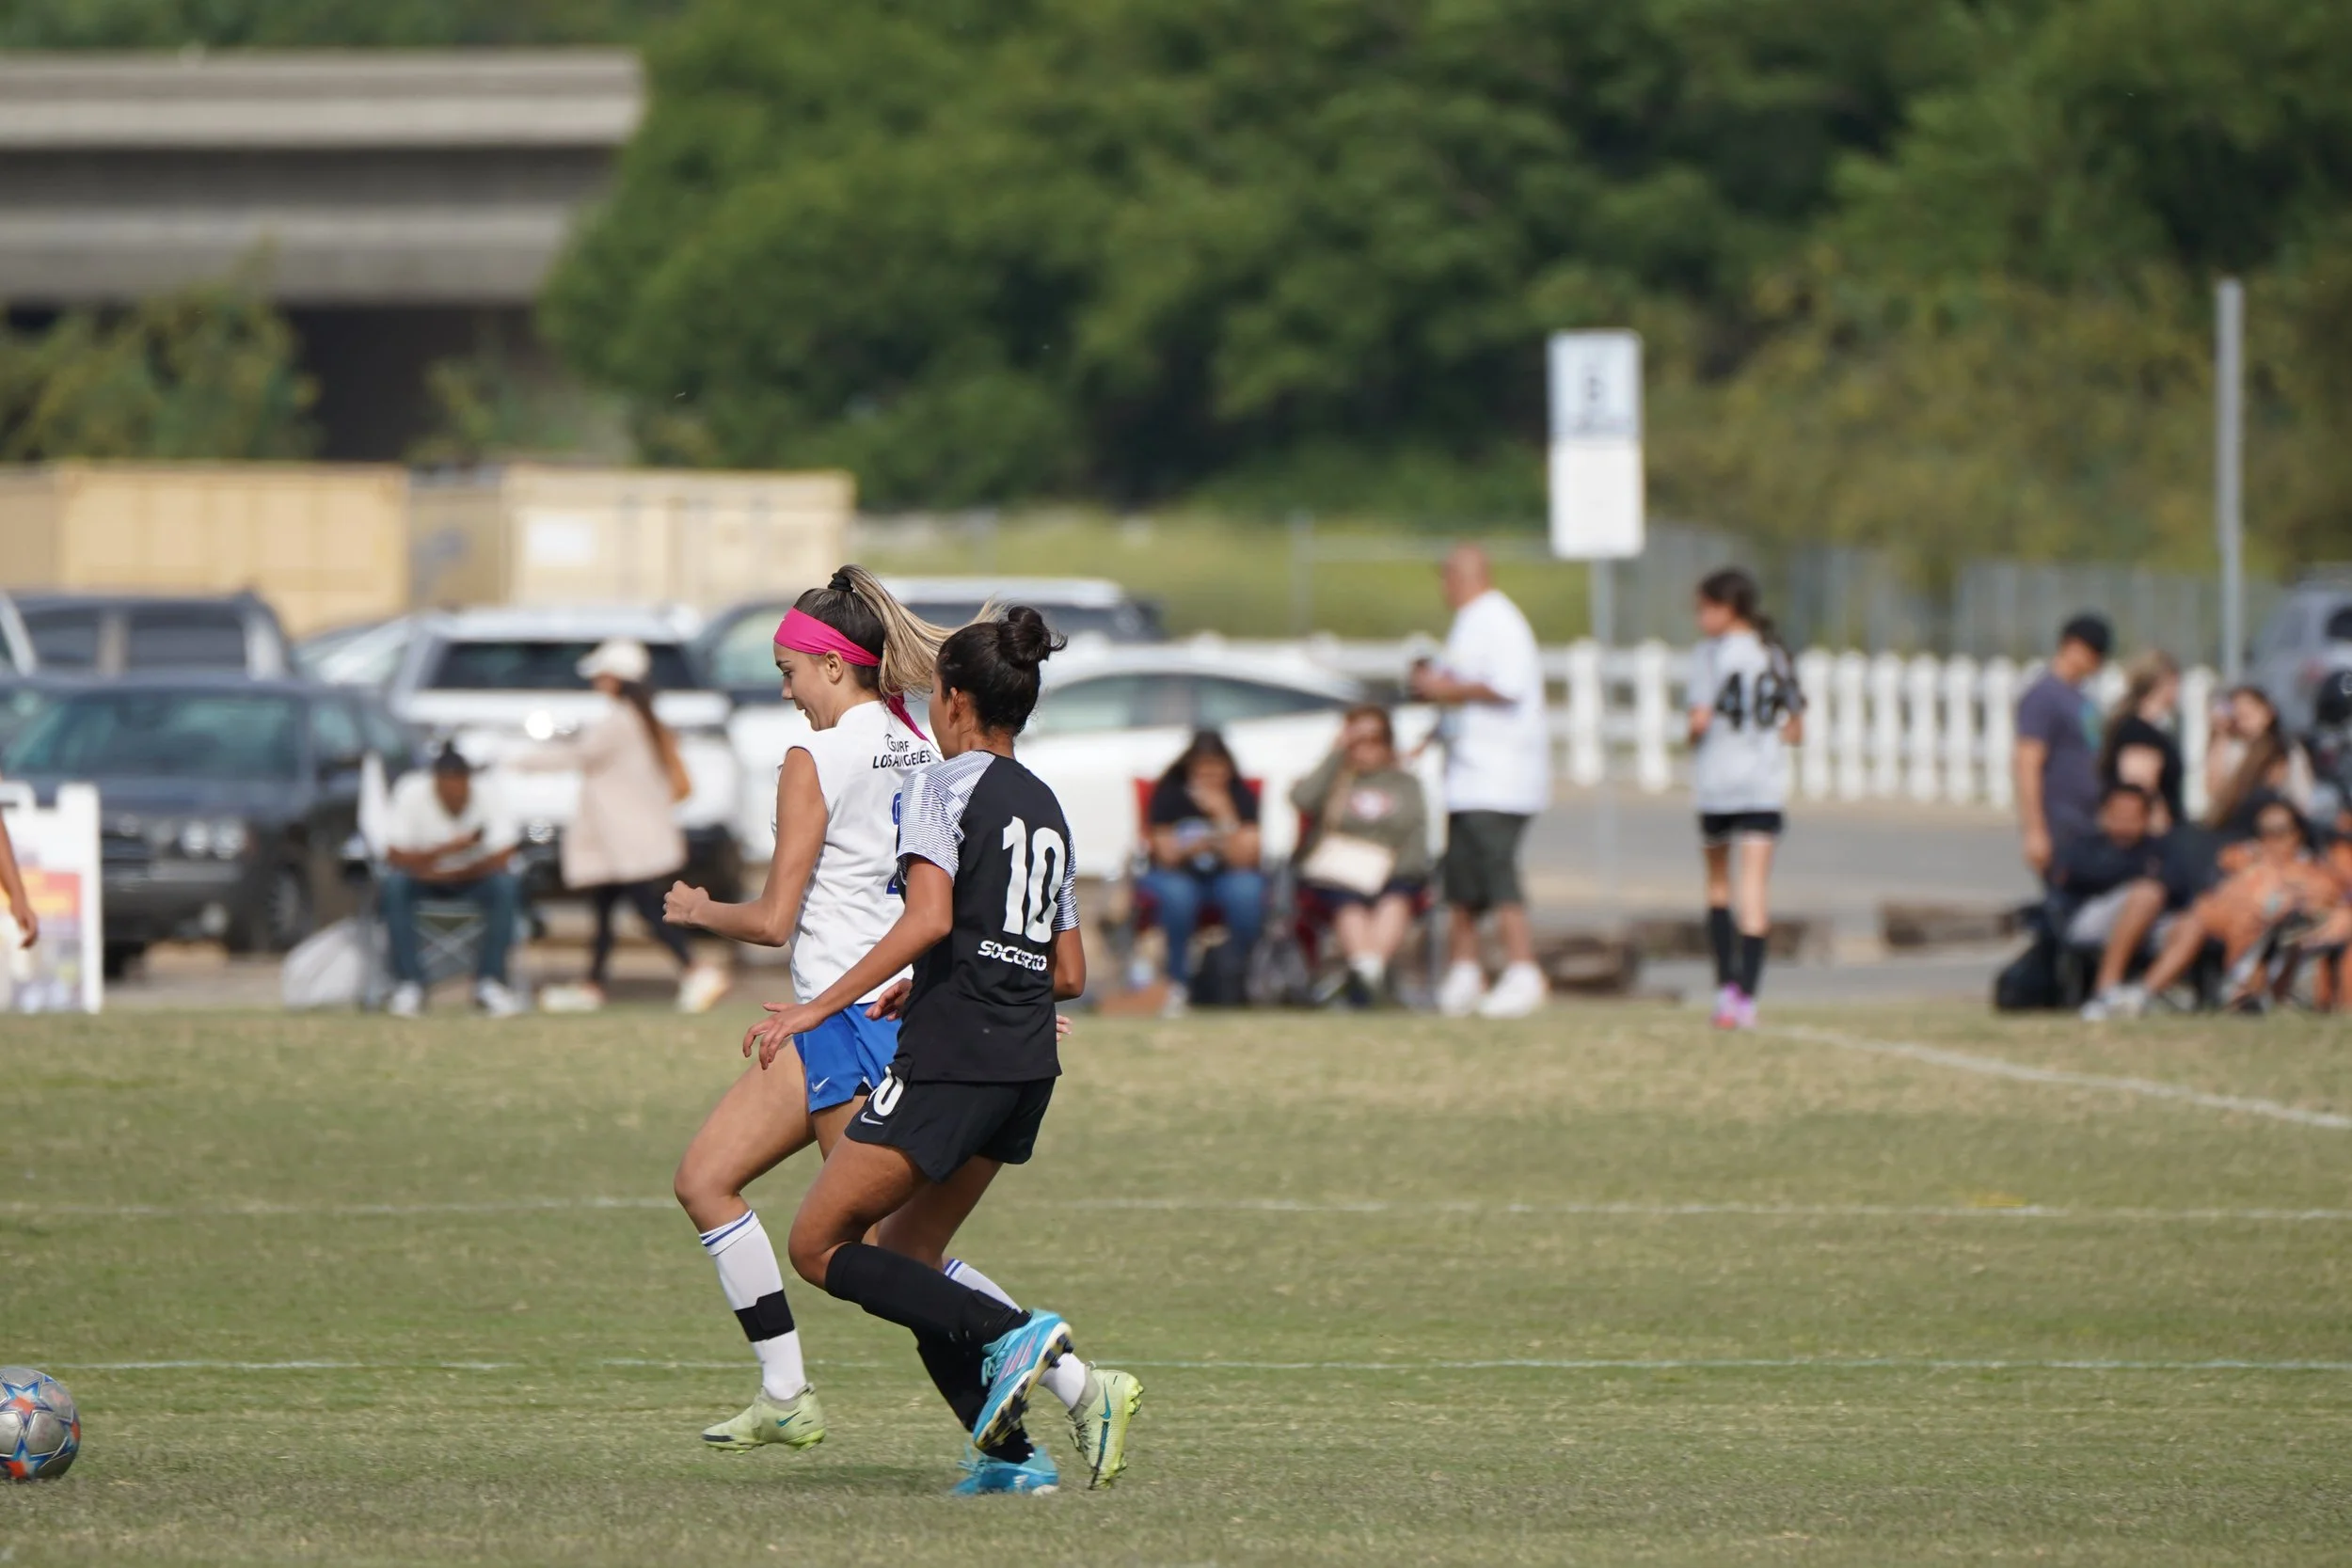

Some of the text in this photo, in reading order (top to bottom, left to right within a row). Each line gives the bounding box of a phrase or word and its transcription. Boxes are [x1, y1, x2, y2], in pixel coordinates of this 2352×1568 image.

[890, 740, 910, 752] SURF
[872, 754, 893, 768] LOS
[1002, 816, 1065, 943] 10
